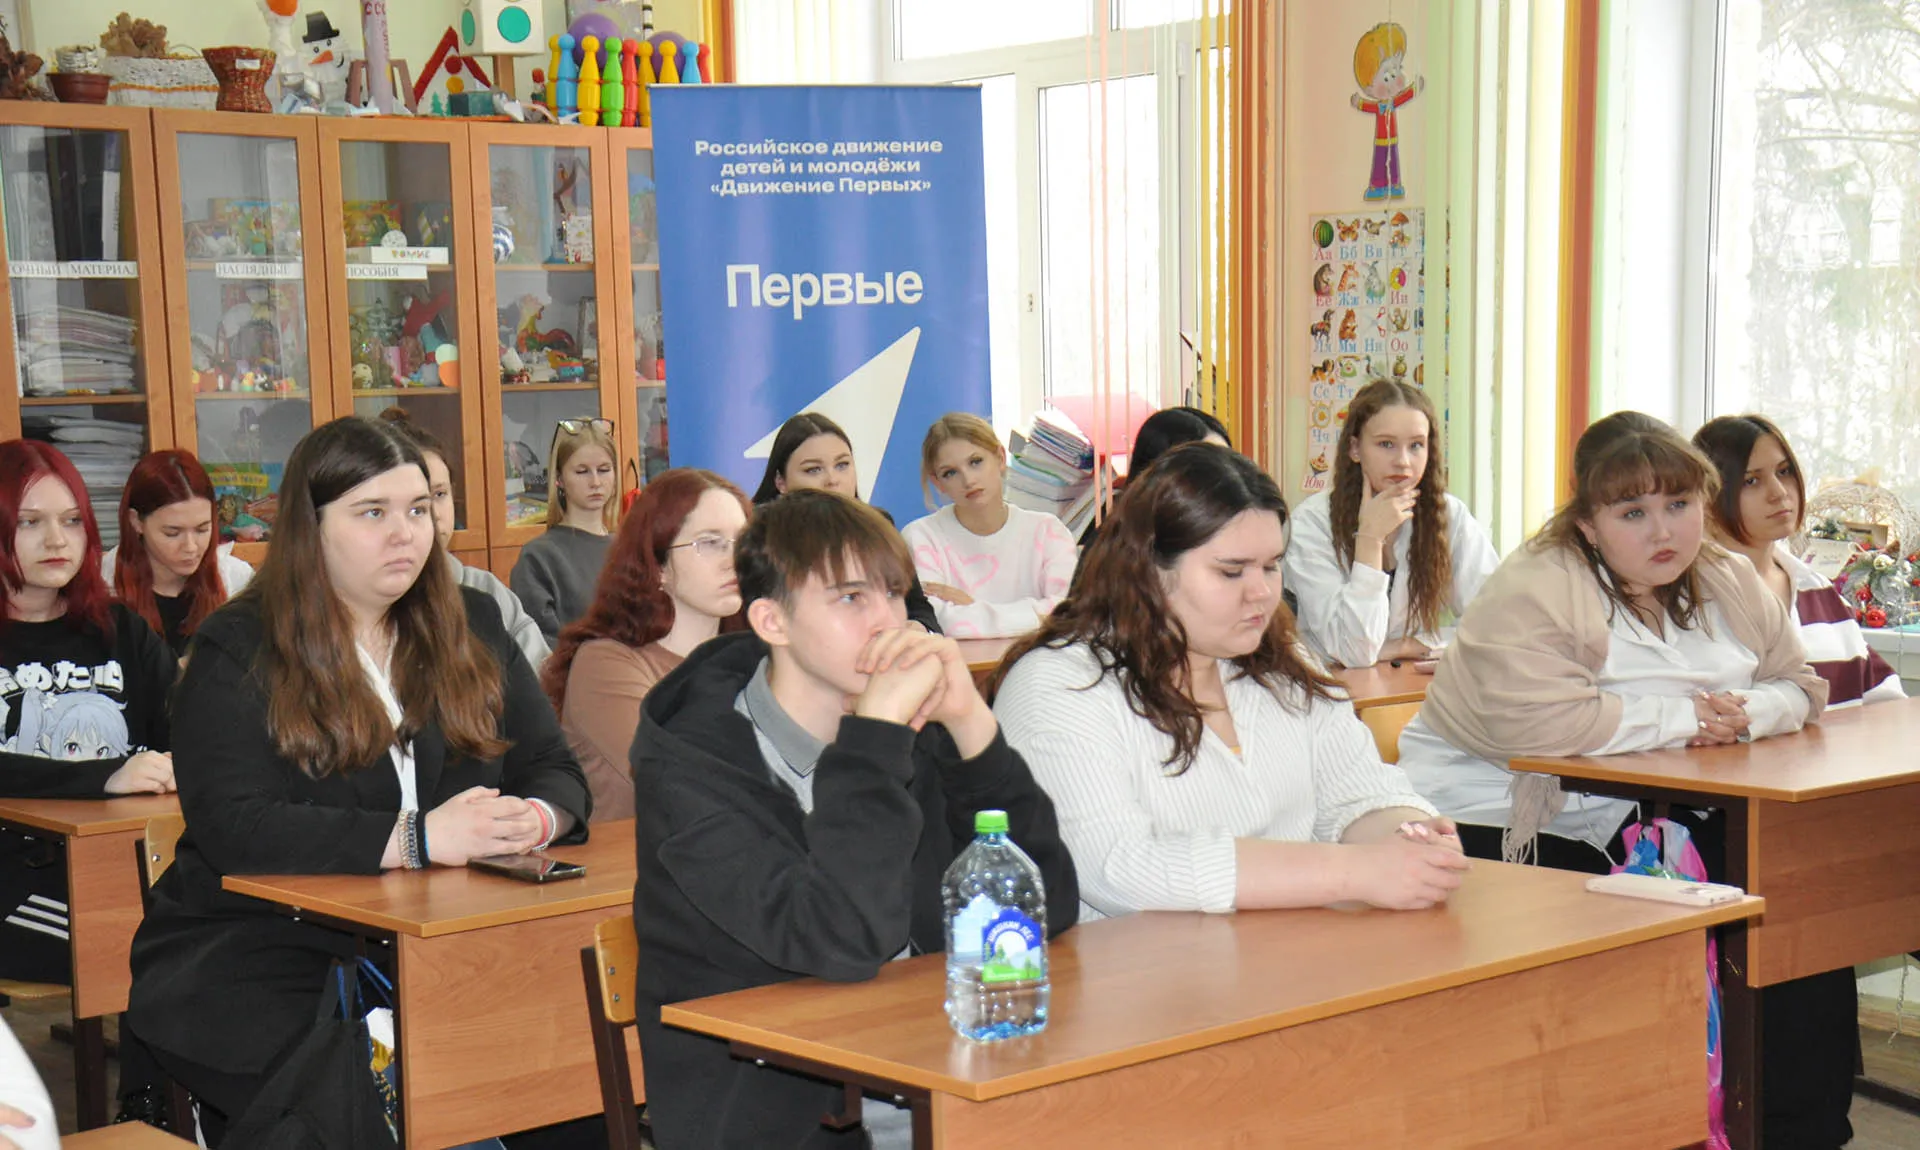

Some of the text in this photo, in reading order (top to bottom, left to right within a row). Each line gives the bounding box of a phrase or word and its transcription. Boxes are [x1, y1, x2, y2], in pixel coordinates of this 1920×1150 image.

[694, 138, 943, 156] Российское движение
[720, 157, 921, 176] детей и молодёжи
[710, 178, 931, 197] «Движение Первых»
[726, 264, 923, 320] Первые
